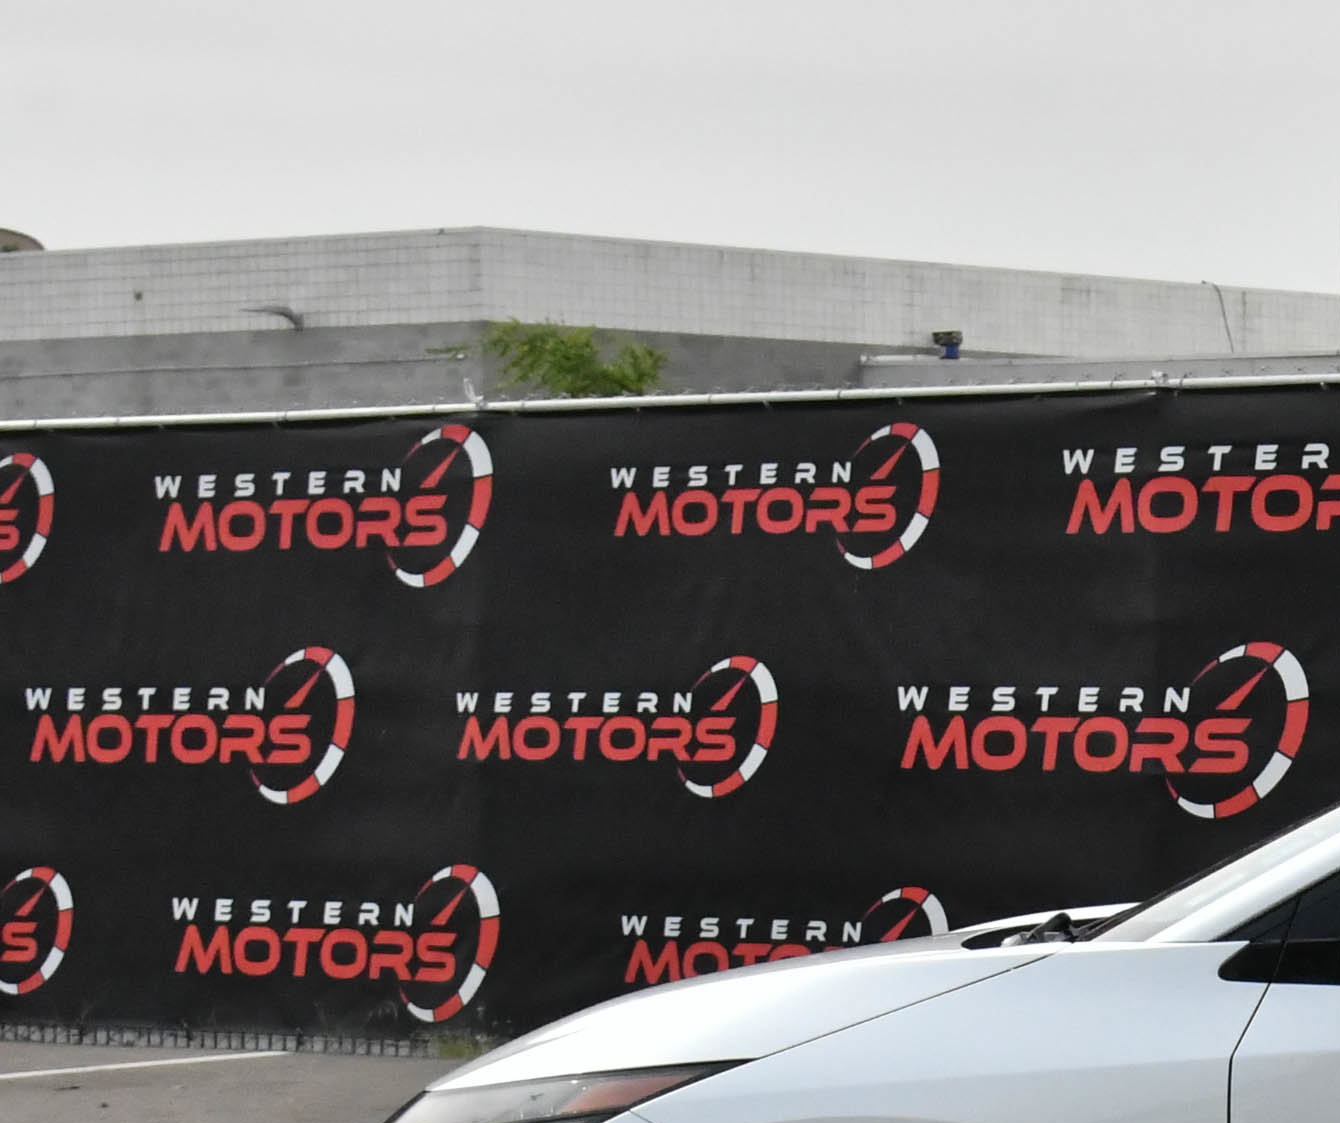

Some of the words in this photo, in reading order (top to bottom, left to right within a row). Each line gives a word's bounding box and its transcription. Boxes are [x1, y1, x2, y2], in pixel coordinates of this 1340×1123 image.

[154, 467, 402, 498] WESTERN
[611, 461, 852, 489] WESTERN
[159, 494, 448, 552] MOTORS
[614, 485, 897, 537] MOTORS
[25, 687, 265, 711] WESTERN
[456, 691, 693, 713] WESTERN
[897, 686, 1191, 713] WESTERN
[29, 713, 312, 764] MOTORS
[457, 714, 737, 762] MOTORS
[901, 714, 1252, 774] MOTORS
[172, 897, 414, 927] WESTERN
[621, 915, 862, 943] WESTERN
[175, 924, 457, 983] MOTORS
